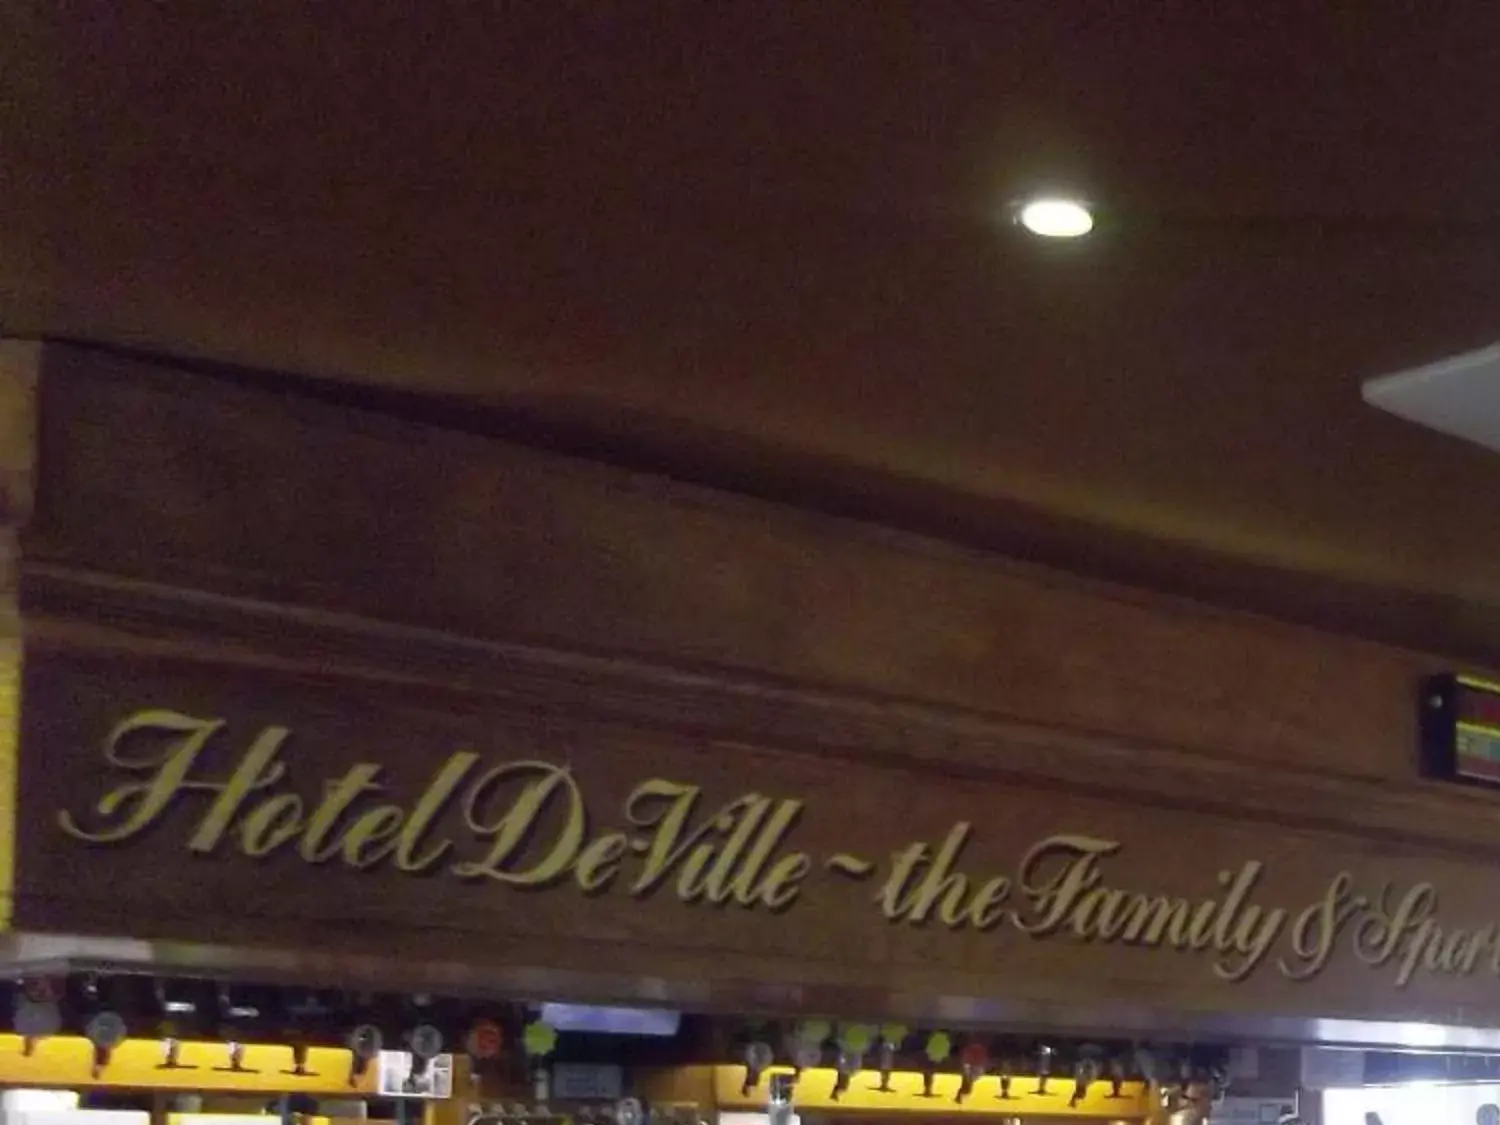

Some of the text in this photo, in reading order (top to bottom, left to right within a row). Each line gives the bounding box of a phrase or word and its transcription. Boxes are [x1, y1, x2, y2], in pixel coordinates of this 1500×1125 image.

[58, 710, 480, 872] Hotel
[878, 822, 1010, 926] the
[1012, 834, 1287, 978] Family
[1279, 871, 1366, 979] &
